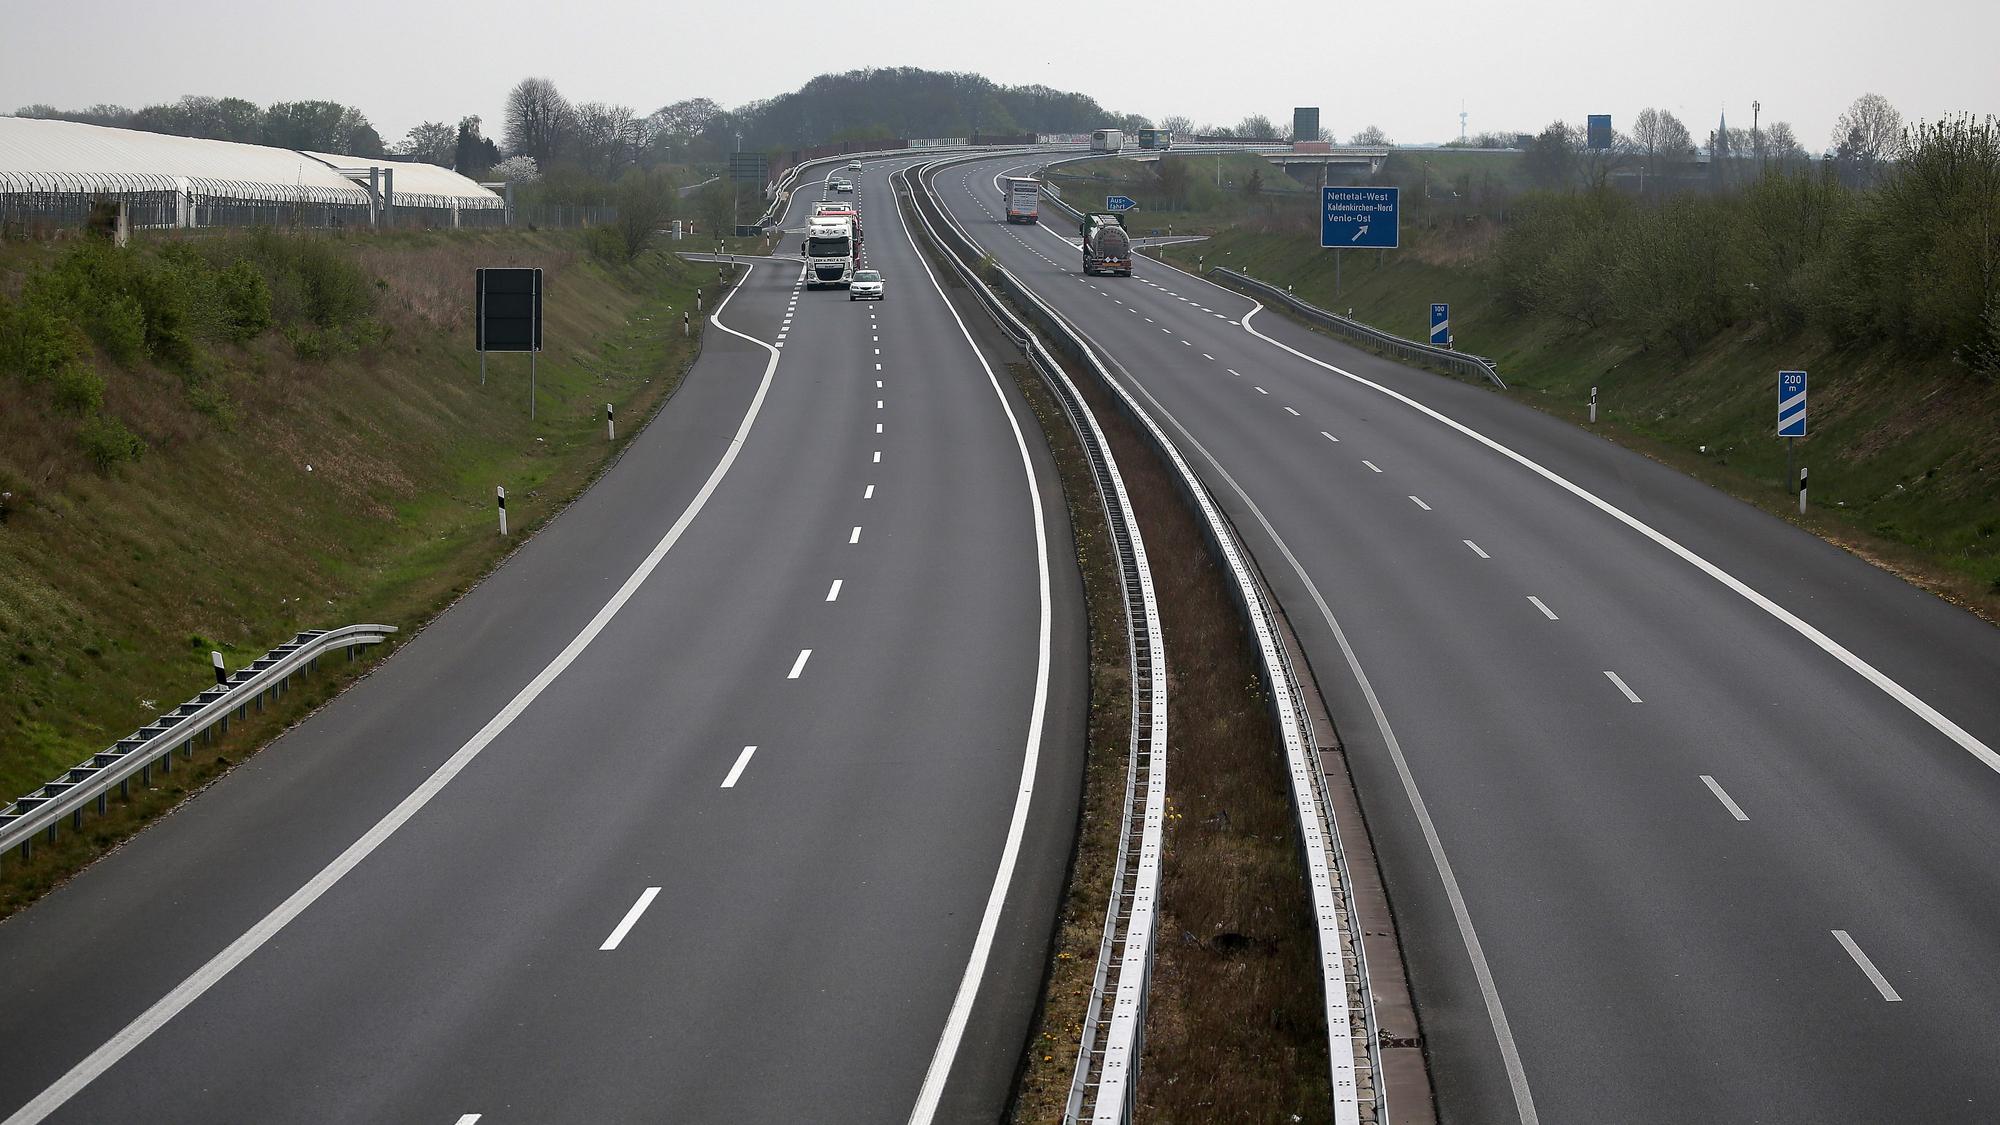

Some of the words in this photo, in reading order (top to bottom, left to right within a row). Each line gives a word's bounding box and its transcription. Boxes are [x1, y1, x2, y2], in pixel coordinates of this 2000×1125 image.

[1327, 192, 1388, 201] Nettetal-West
[1327, 203, 1393, 212] Kaldenkirchen-Nord
[1328, 214, 1371, 222] Venlo-Ost
[1784, 376, 1802, 384] 200
